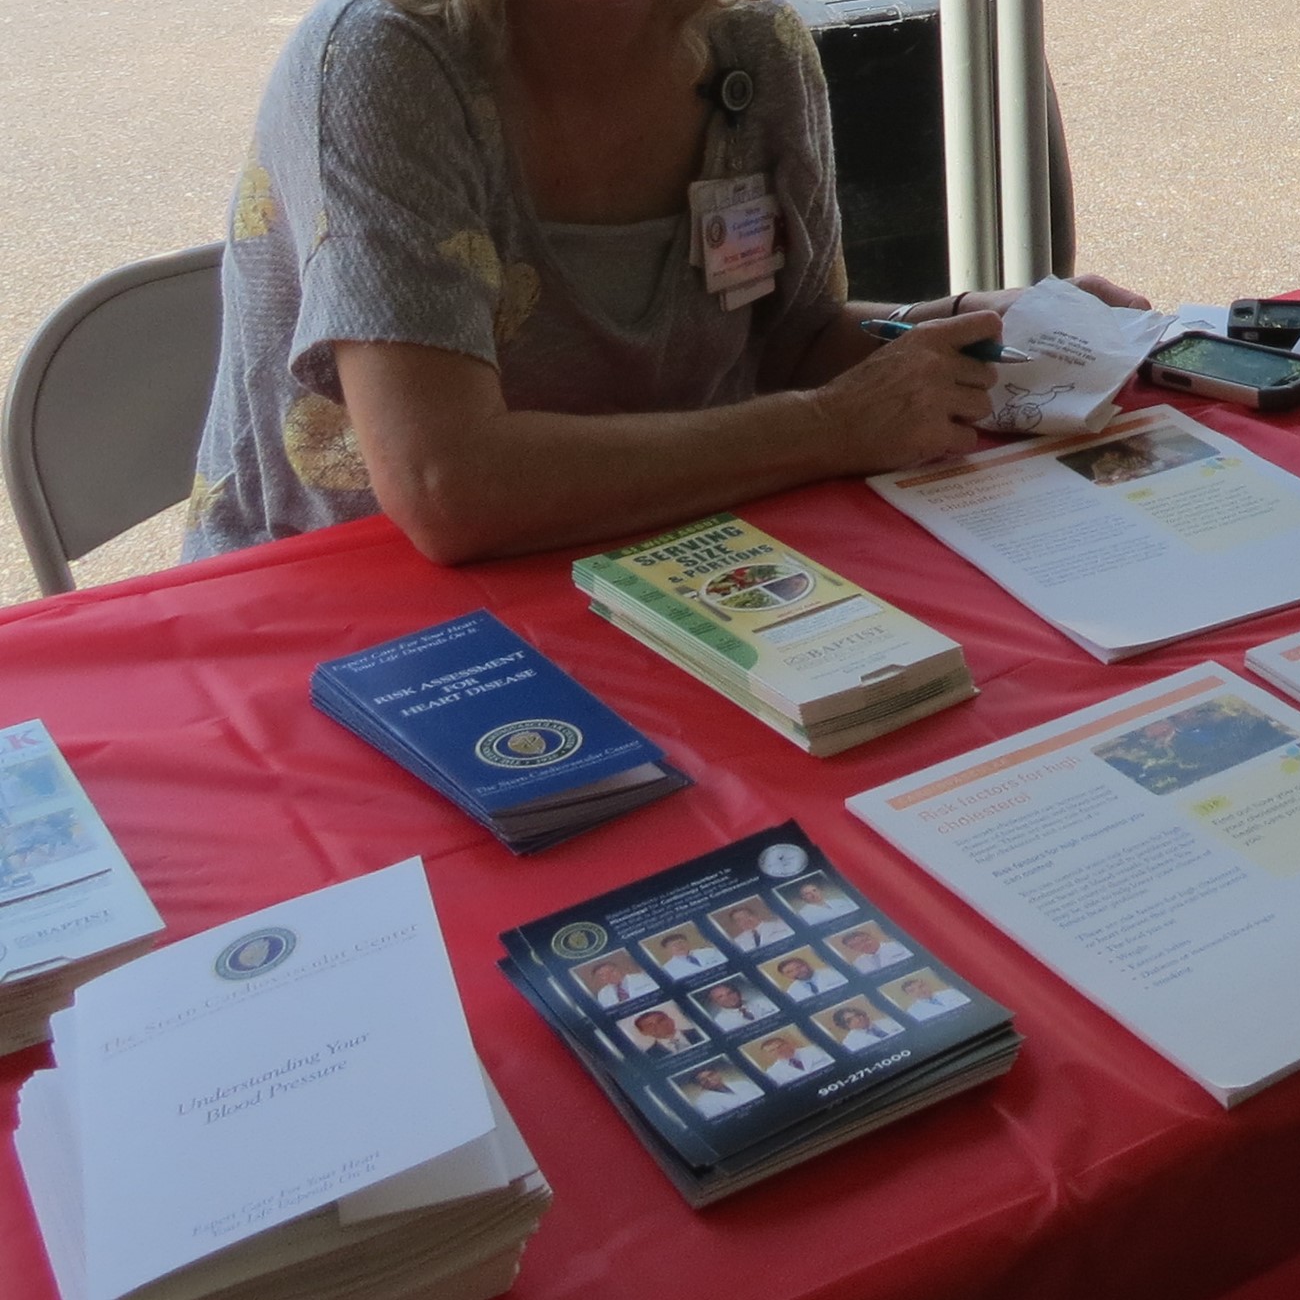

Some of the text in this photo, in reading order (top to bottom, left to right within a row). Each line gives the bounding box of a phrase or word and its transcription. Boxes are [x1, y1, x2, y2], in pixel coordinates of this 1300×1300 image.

[634, 527, 743, 566] SERVING
[676, 544, 733, 567] SIZE
[683, 545, 773, 577] PORTIONS
[807, 627, 884, 658] BAPTIST
[374, 651, 523, 704] RISK ASSESSMENT
[402, 669, 536, 716] HEART DISEASE
[442, 678, 479, 692] FOR
[918, 756, 1081, 822] Risk factors for high
[938, 793, 1030, 834] cholesterol
[179, 1032, 366, 1115] Understanding Your
[207, 1061, 346, 1124] Blood Pressure
[817, 1049, 912, 1098] 901-271-1000
